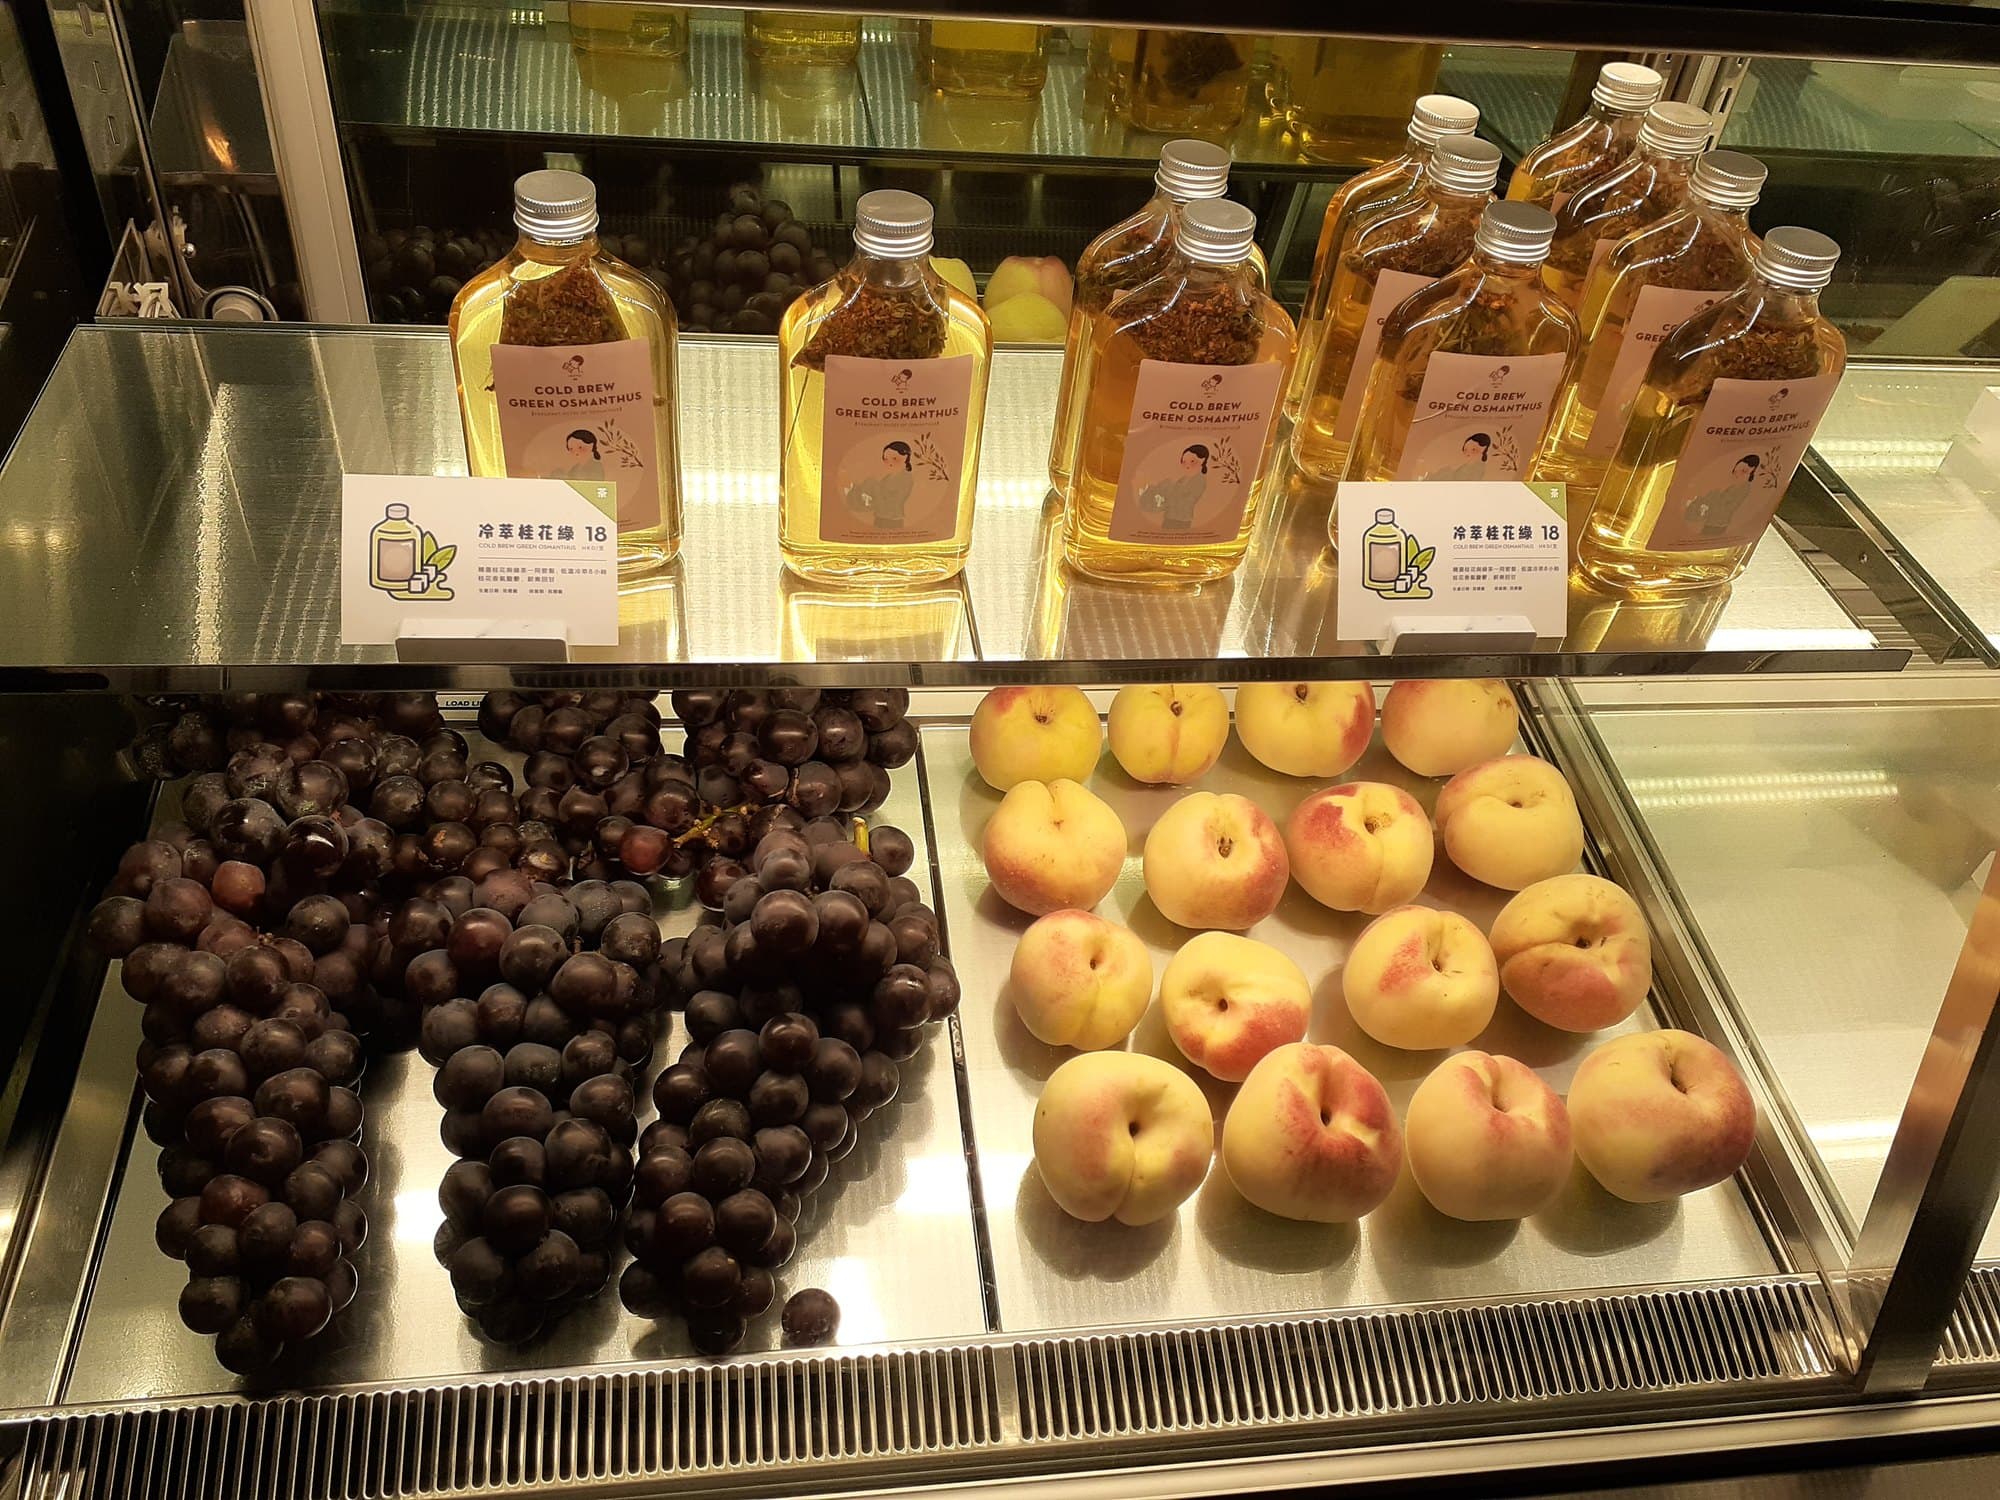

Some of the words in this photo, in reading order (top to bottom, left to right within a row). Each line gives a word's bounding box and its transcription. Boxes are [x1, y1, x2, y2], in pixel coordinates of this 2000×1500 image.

[1663, 324, 1677, 332] CO
[1636, 332, 1665, 343] GREE
[534, 385, 573, 395] COLD
[578, 382, 615, 394] BREW
[508, 398, 555, 409] GREEN
[559, 391, 642, 408] OSMANTHUS
[861, 396, 897, 407] COLD
[901, 396, 937, 407] BREW
[1456, 391, 1490, 401] COLD
[1493, 391, 1527, 401] BREW
[1169, 401, 1204, 411] COLD
[1207, 401, 1242, 411] BREW
[1428, 401, 1470, 412] GREEN
[1472, 401, 1543, 413] OSMANTHUS
[835, 407, 878, 419] GREEN
[882, 407, 959, 420] OSMANTHUS
[1142, 411, 1184, 422] GREEN
[1187, 412, 1261, 423] OSMANTHUS
[1735, 415, 1767, 425] COLD
[1768, 412, 1799, 424] BREW
[1706, 426, 1746, 436] GREEN
[1748, 420, 1811, 436] OSMANTHUS
[597, 487, 608, 499] 茶
[478, 523, 575, 541] 冷萃桂花綠
[585, 526, 608, 542] 18
[1453, 524, 1533, 541] 冷萃桂花綠
[1541, 525, 1560, 540] 18
